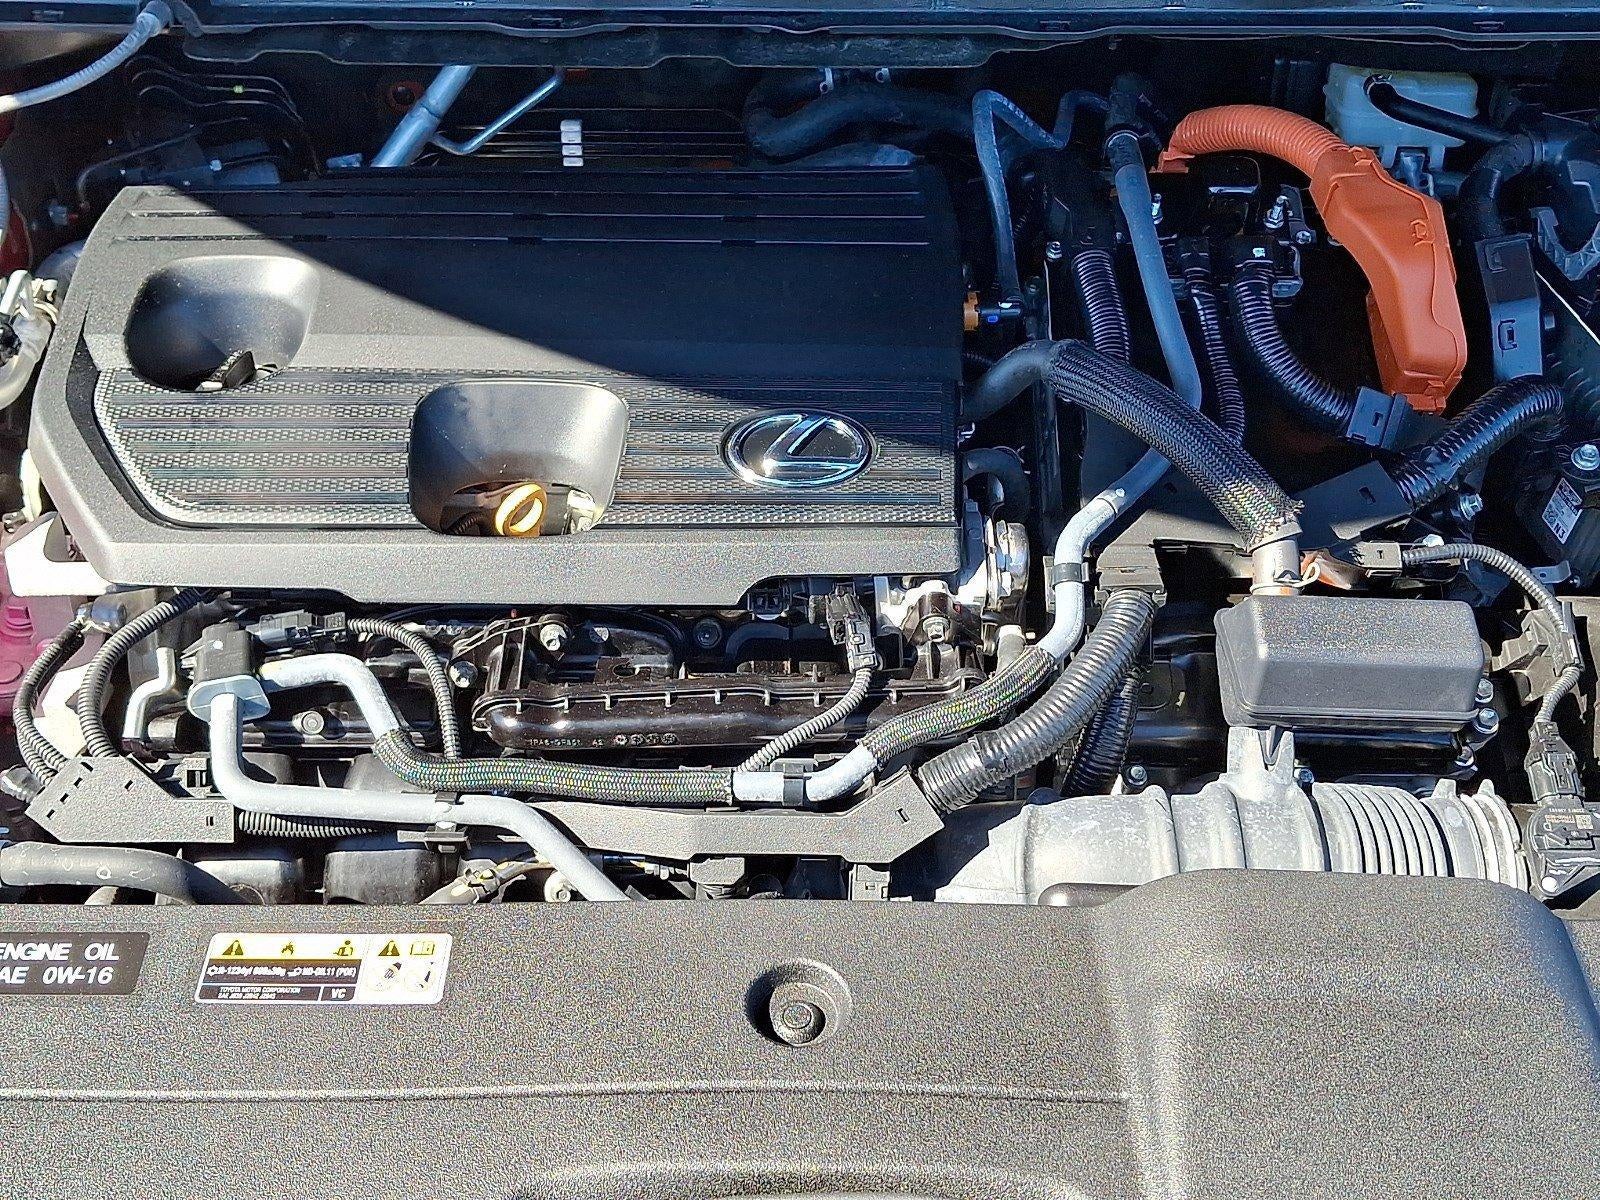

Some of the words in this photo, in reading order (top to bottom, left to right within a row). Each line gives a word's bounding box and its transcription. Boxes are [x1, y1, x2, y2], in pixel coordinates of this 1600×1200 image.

[84, 942, 120, 961] OIL
[42, 966, 115, 985] 0W-16
[331, 988, 347, 999] VC
